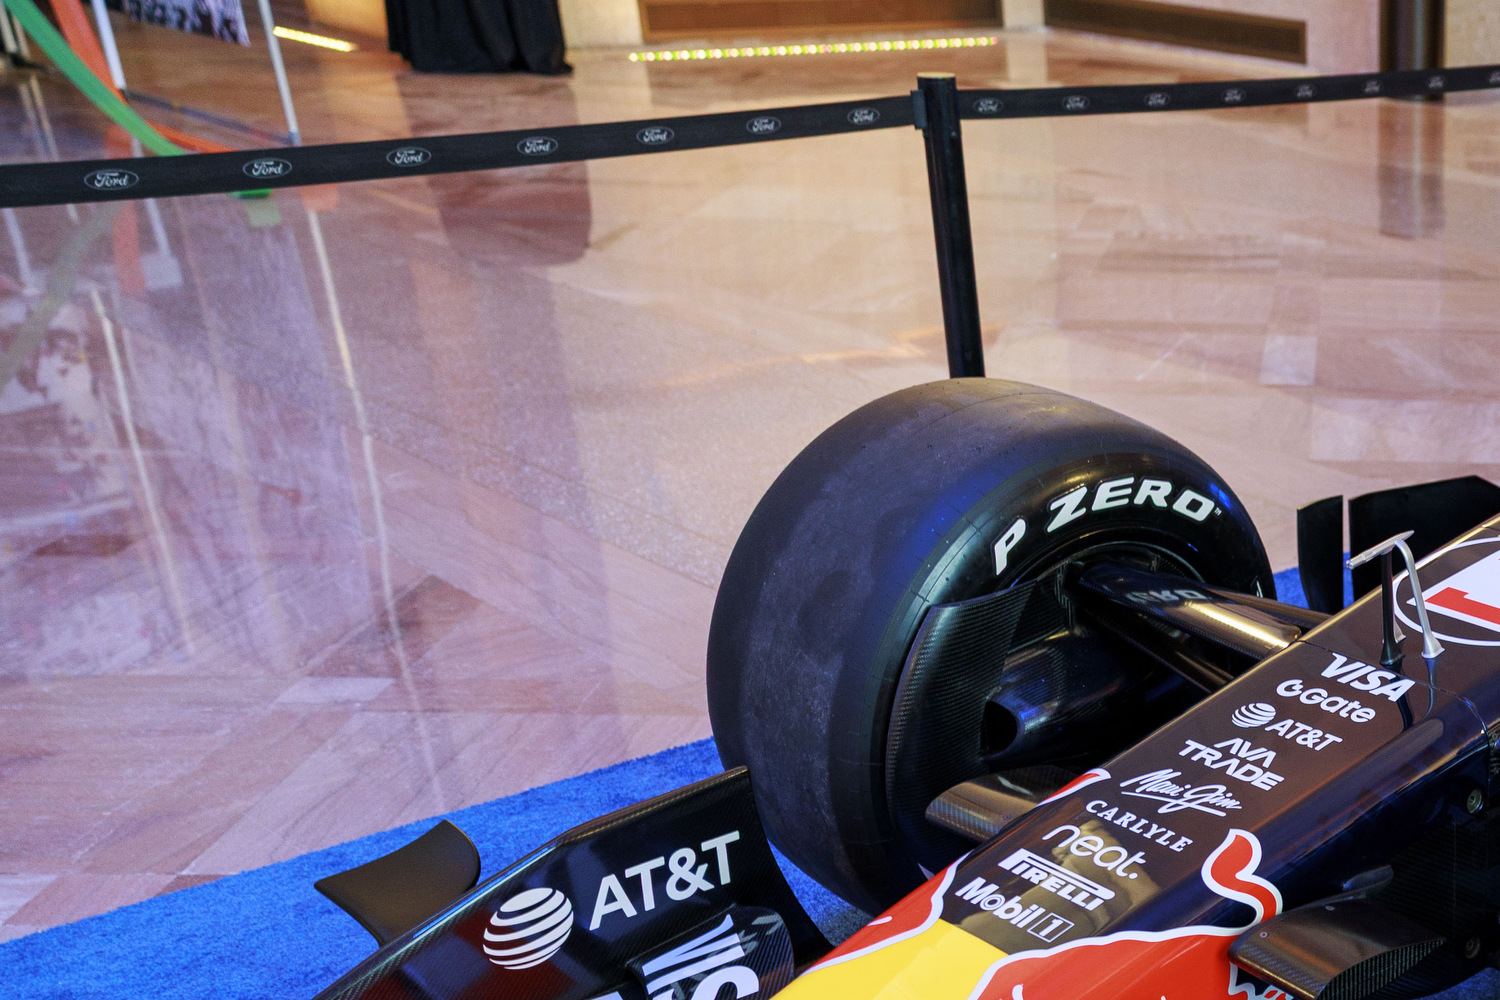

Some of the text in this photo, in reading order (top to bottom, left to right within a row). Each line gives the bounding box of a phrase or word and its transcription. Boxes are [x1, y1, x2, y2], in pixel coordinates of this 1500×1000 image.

[643, 128, 667, 142] Ford
[752, 118, 775, 132] Ford
[394, 150, 423, 165] Ford
[523, 138, 551, 153] Ford
[95, 172, 129, 188] Ford
[251, 161, 284, 177] Ford
[994, 476, 1216, 576] P ZERO
[1320, 652, 1416, 702] VISA
[1299, 687, 1377, 724] Gate
[1213, 737, 1278, 769] AVA
[1264, 718, 1343, 751] AT&T
[1178, 739, 1285, 791] TRADE
[1119, 768, 1243, 815] Maui Jim
[1085, 800, 1194, 853] CARLYLE
[588, 830, 740, 931] AT&T
[998, 848, 1116, 911] PIRELLI
[955, 876, 1046, 929] Mobil
